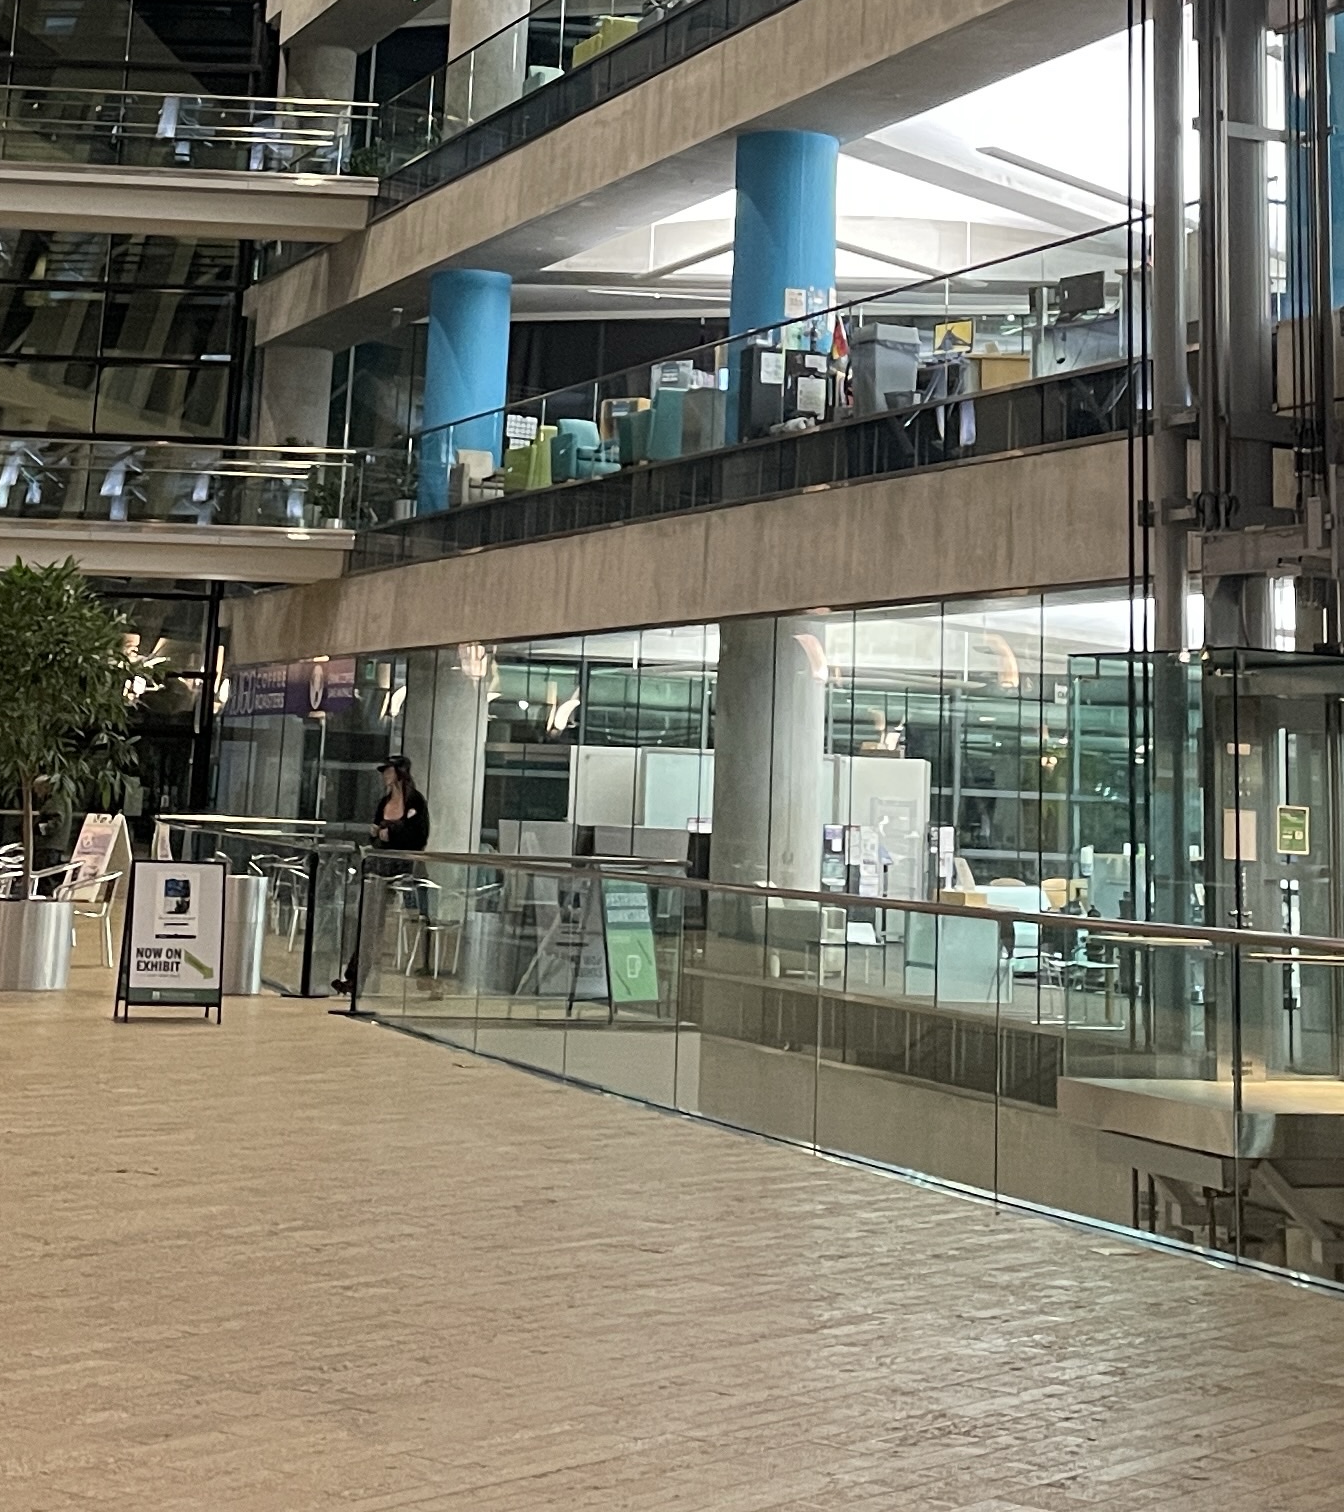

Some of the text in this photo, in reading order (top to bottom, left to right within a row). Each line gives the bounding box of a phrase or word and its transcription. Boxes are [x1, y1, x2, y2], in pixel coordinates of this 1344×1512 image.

[136, 948, 182, 960] NOW ON
[136, 960, 181, 973] EXHIBIT
